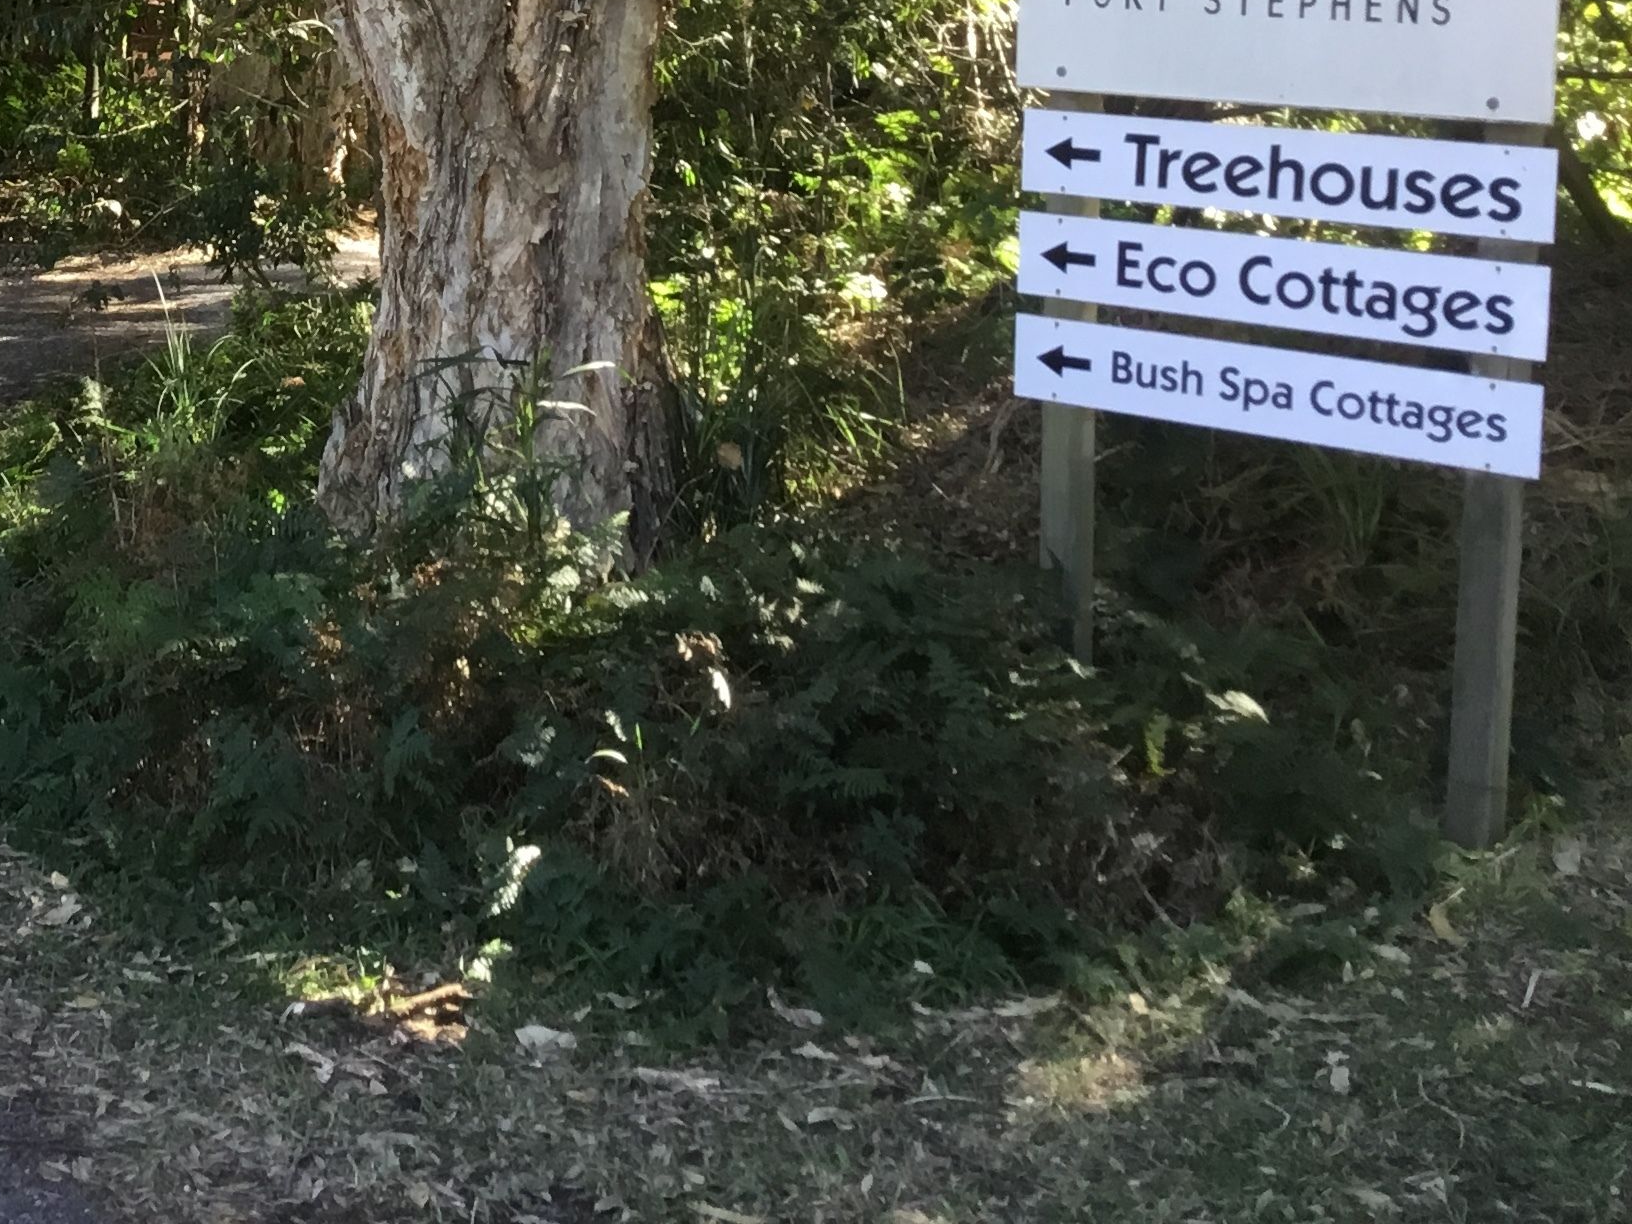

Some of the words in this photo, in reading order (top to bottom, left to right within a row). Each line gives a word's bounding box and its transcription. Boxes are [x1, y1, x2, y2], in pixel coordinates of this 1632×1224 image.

[1124, 133, 1522, 223] Treehouses
[1116, 240, 1217, 296] Eco
[1239, 255, 1515, 338] Cottages
[1111, 351, 1204, 396] Bush
[1219, 366, 1294, 411] Spa
[1310, 381, 1508, 443] Cottages
